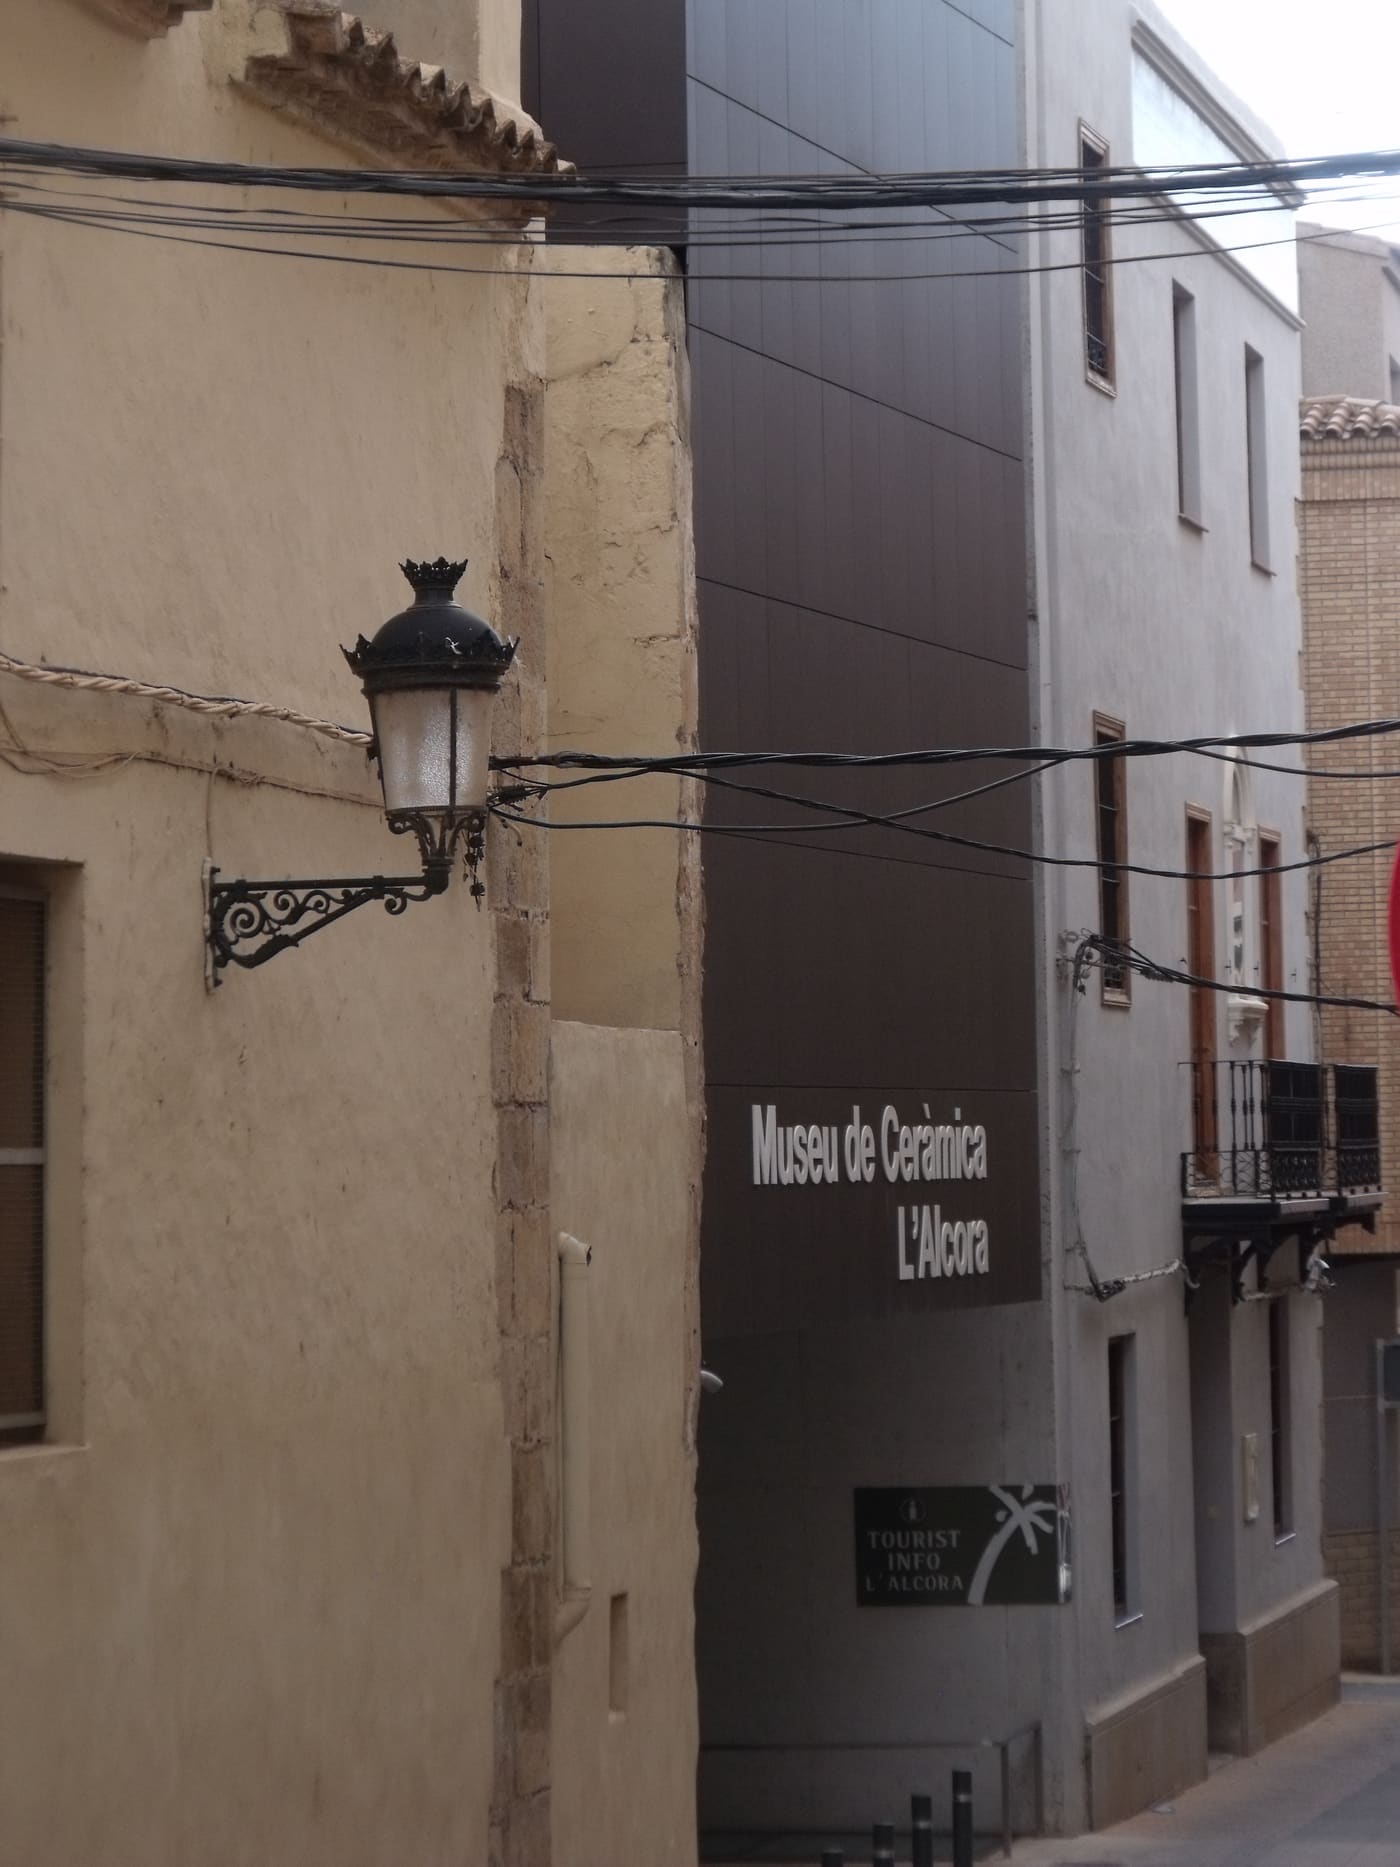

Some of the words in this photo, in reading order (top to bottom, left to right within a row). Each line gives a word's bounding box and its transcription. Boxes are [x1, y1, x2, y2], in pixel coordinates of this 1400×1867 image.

[752, 1104, 839, 1185] Museu
[845, 1104, 876, 1183] de
[881, 1103, 988, 1183] Ceràmica
[897, 1204, 990, 1280] L'Alcora
[867, 1530, 961, 1549] TOURIST
[888, 1552, 941, 1571] INFO
